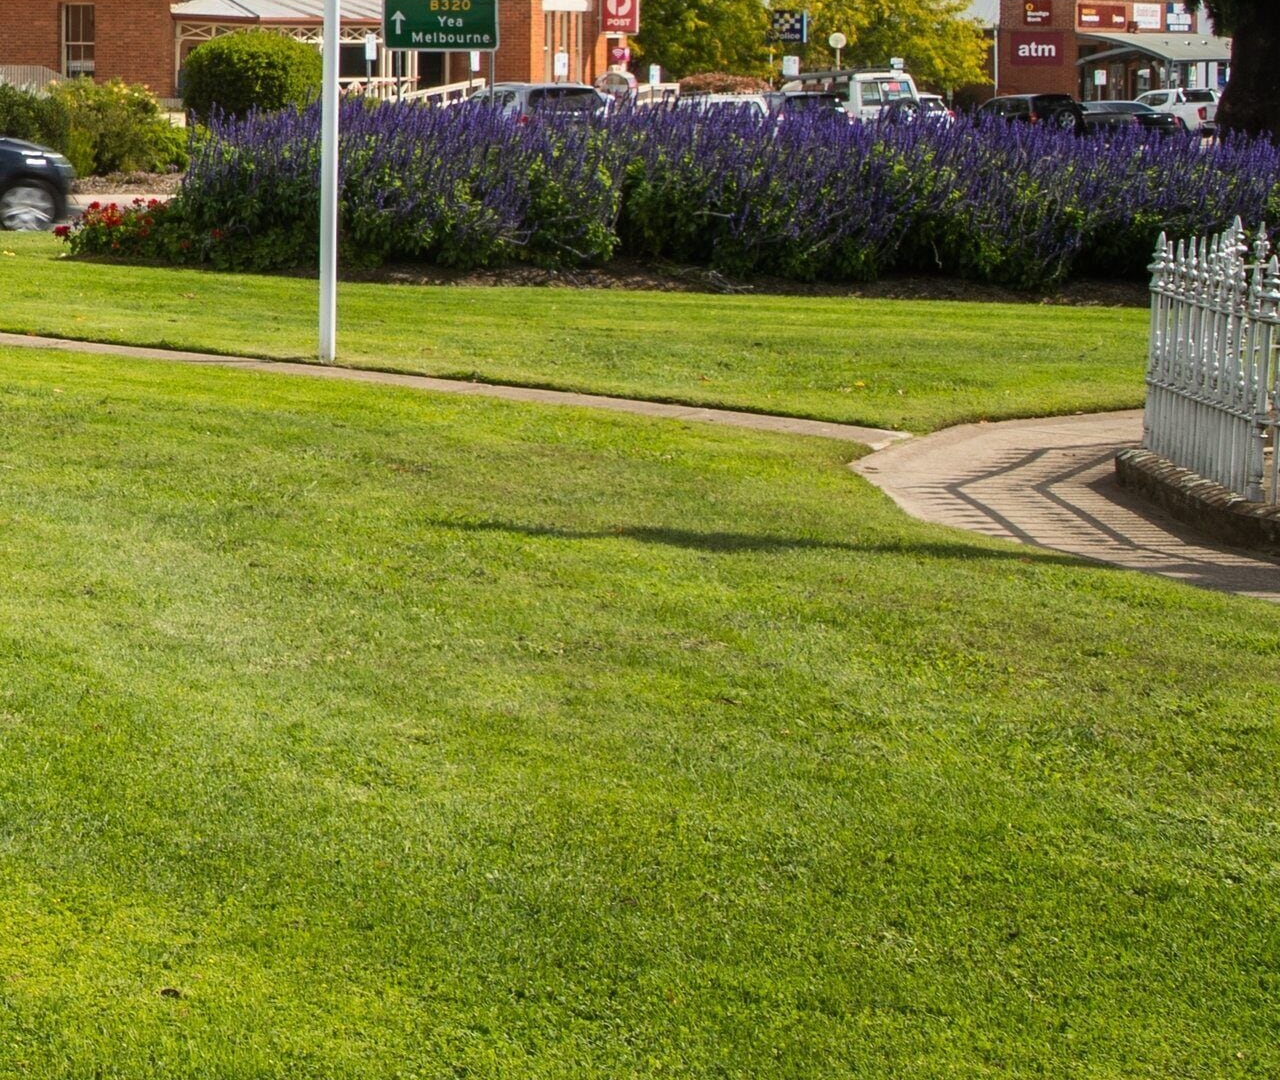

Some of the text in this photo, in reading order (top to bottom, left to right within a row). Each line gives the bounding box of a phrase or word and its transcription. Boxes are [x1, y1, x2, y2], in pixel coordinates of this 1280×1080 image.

[429, 0, 471, 11] B320
[437, 15, 464, 27] Yea
[607, 18, 632, 26] POST
[411, 31, 490, 43] Melbourne
[1018, 41, 1056, 57] atm
